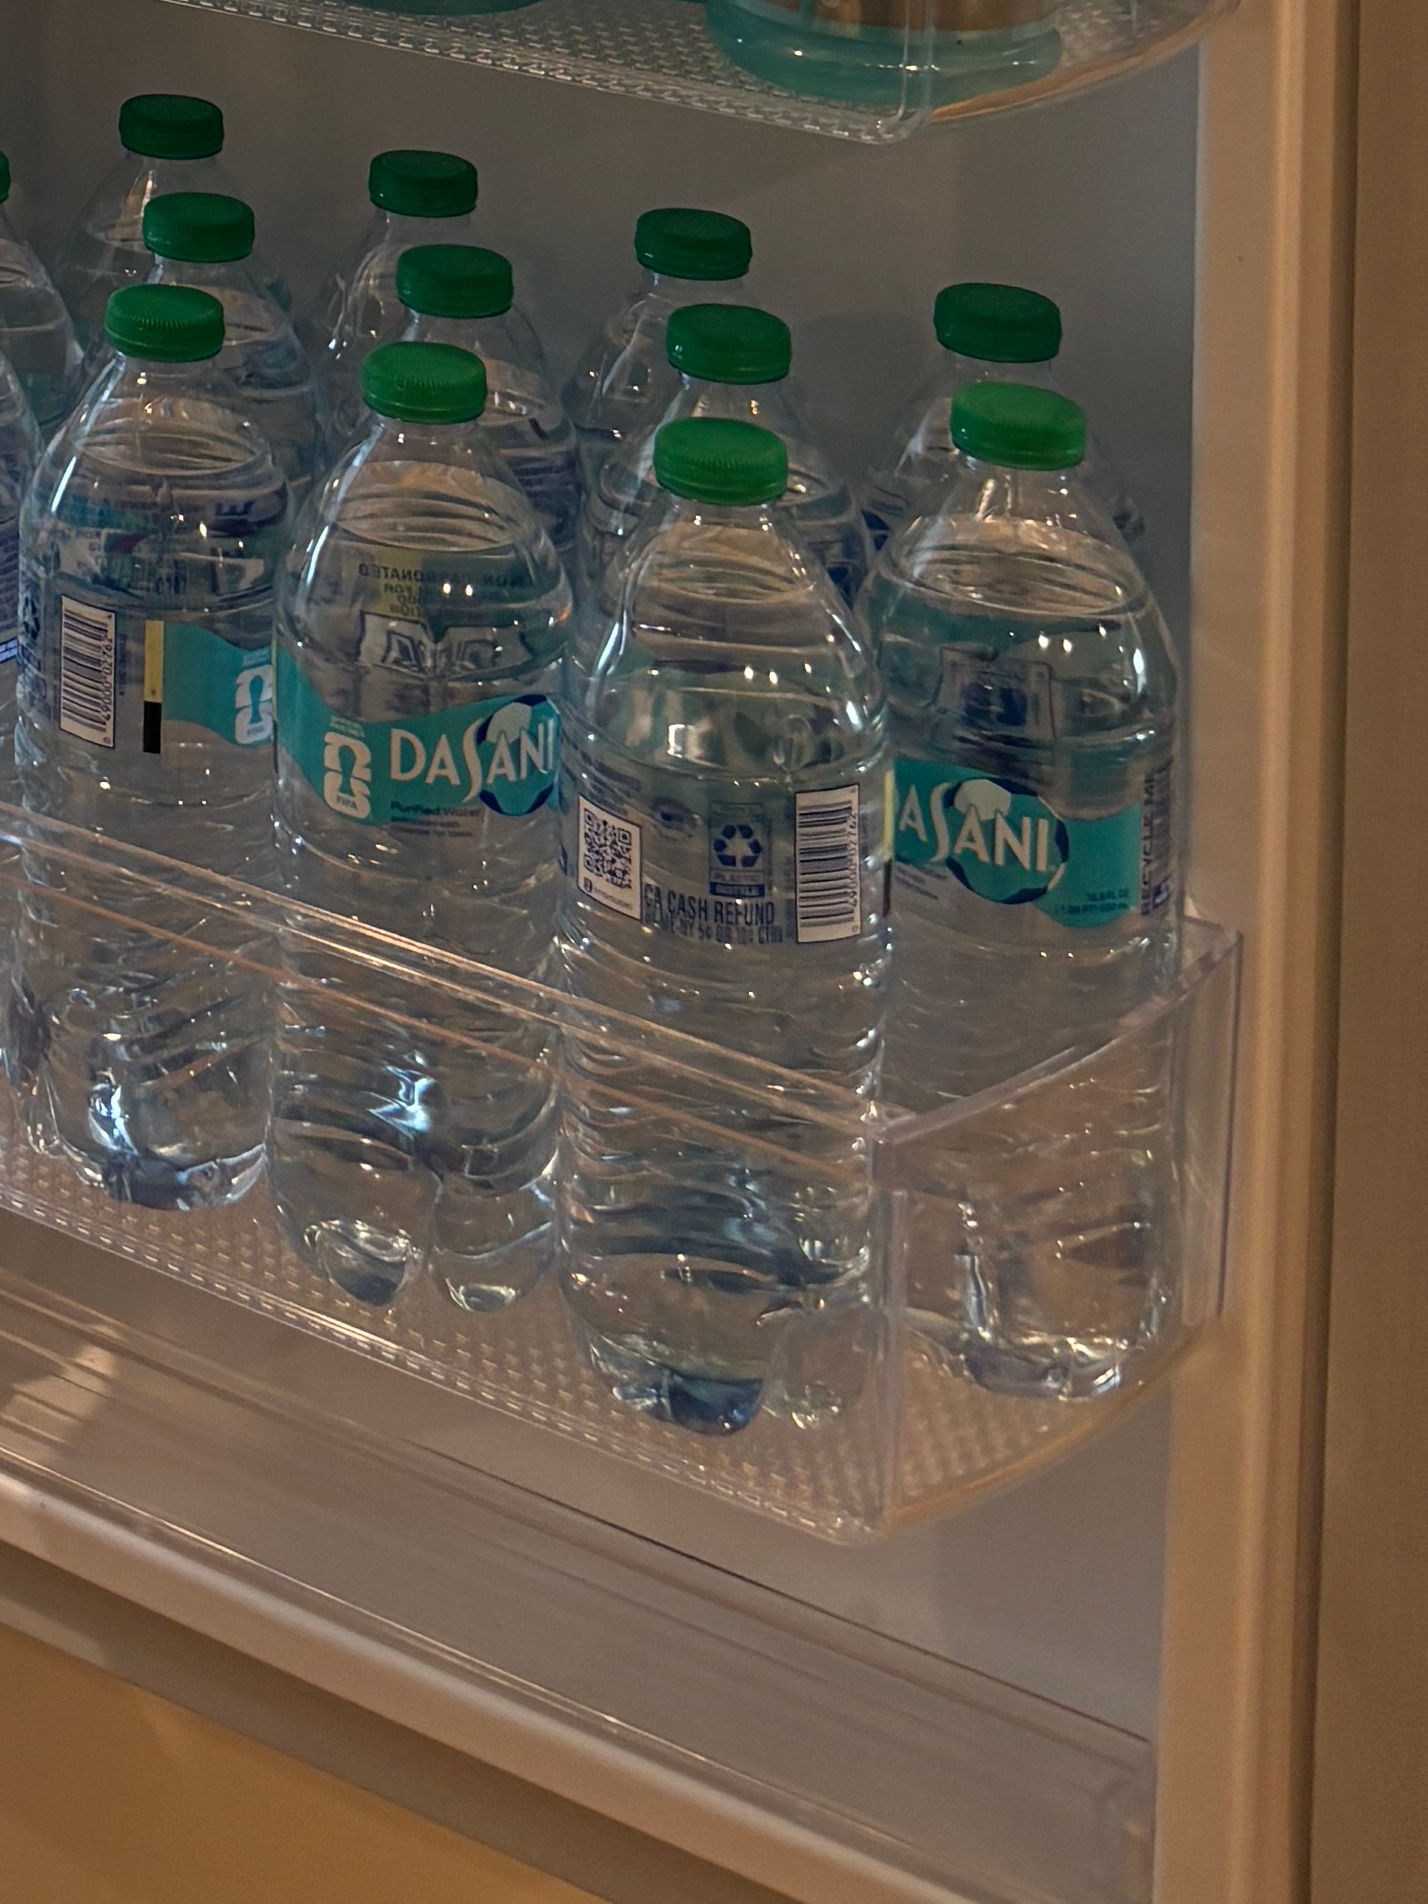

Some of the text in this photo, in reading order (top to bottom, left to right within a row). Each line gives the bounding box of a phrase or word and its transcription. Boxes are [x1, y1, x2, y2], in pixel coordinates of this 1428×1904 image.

[100, 680, 113, 722] 49000
[389, 718, 555, 804] DASANI
[898, 782, 1051, 874] ASANI
[667, 891, 708, 922] CASH
[714, 900, 775, 926] REFUND
